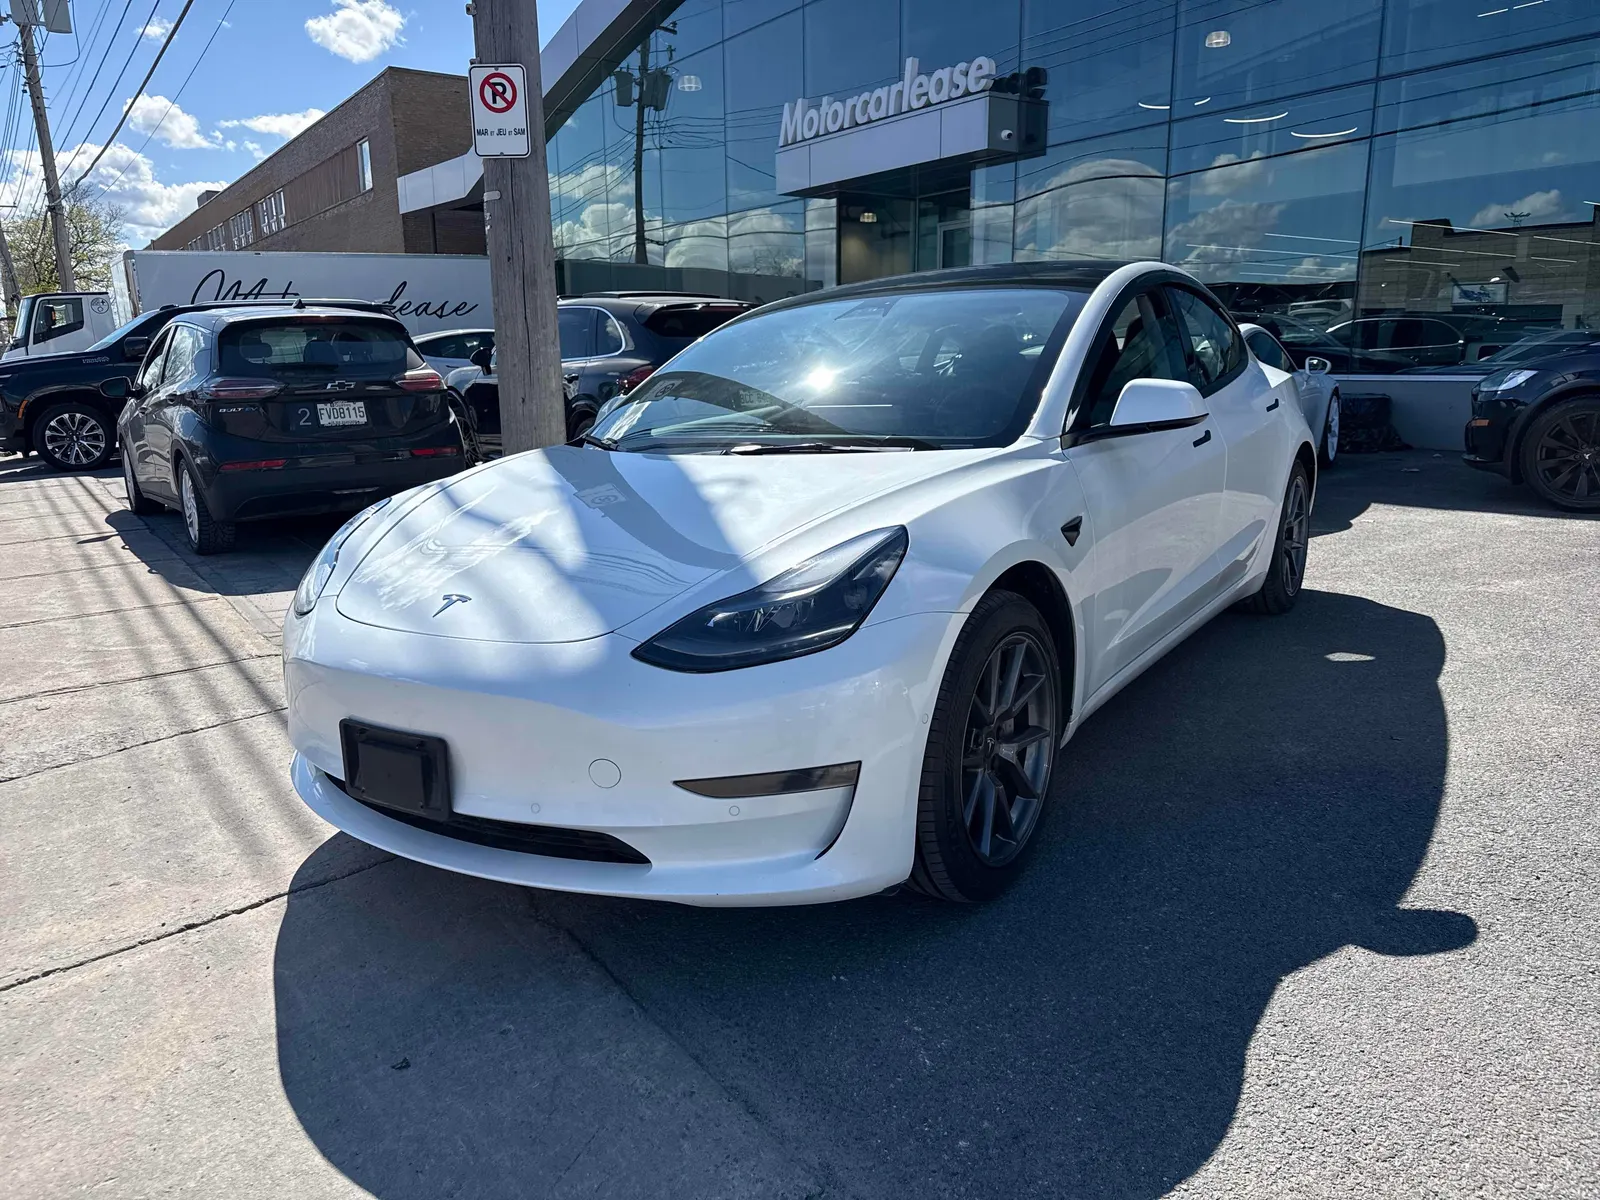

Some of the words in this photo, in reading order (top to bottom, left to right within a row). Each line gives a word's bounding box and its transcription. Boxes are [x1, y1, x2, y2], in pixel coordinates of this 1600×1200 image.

[778, 56, 996, 147] Motorcarlease
[496, 128, 507, 136] JEU
[298, 408, 312, 425] 2
[319, 406, 365, 420] FVD8115
